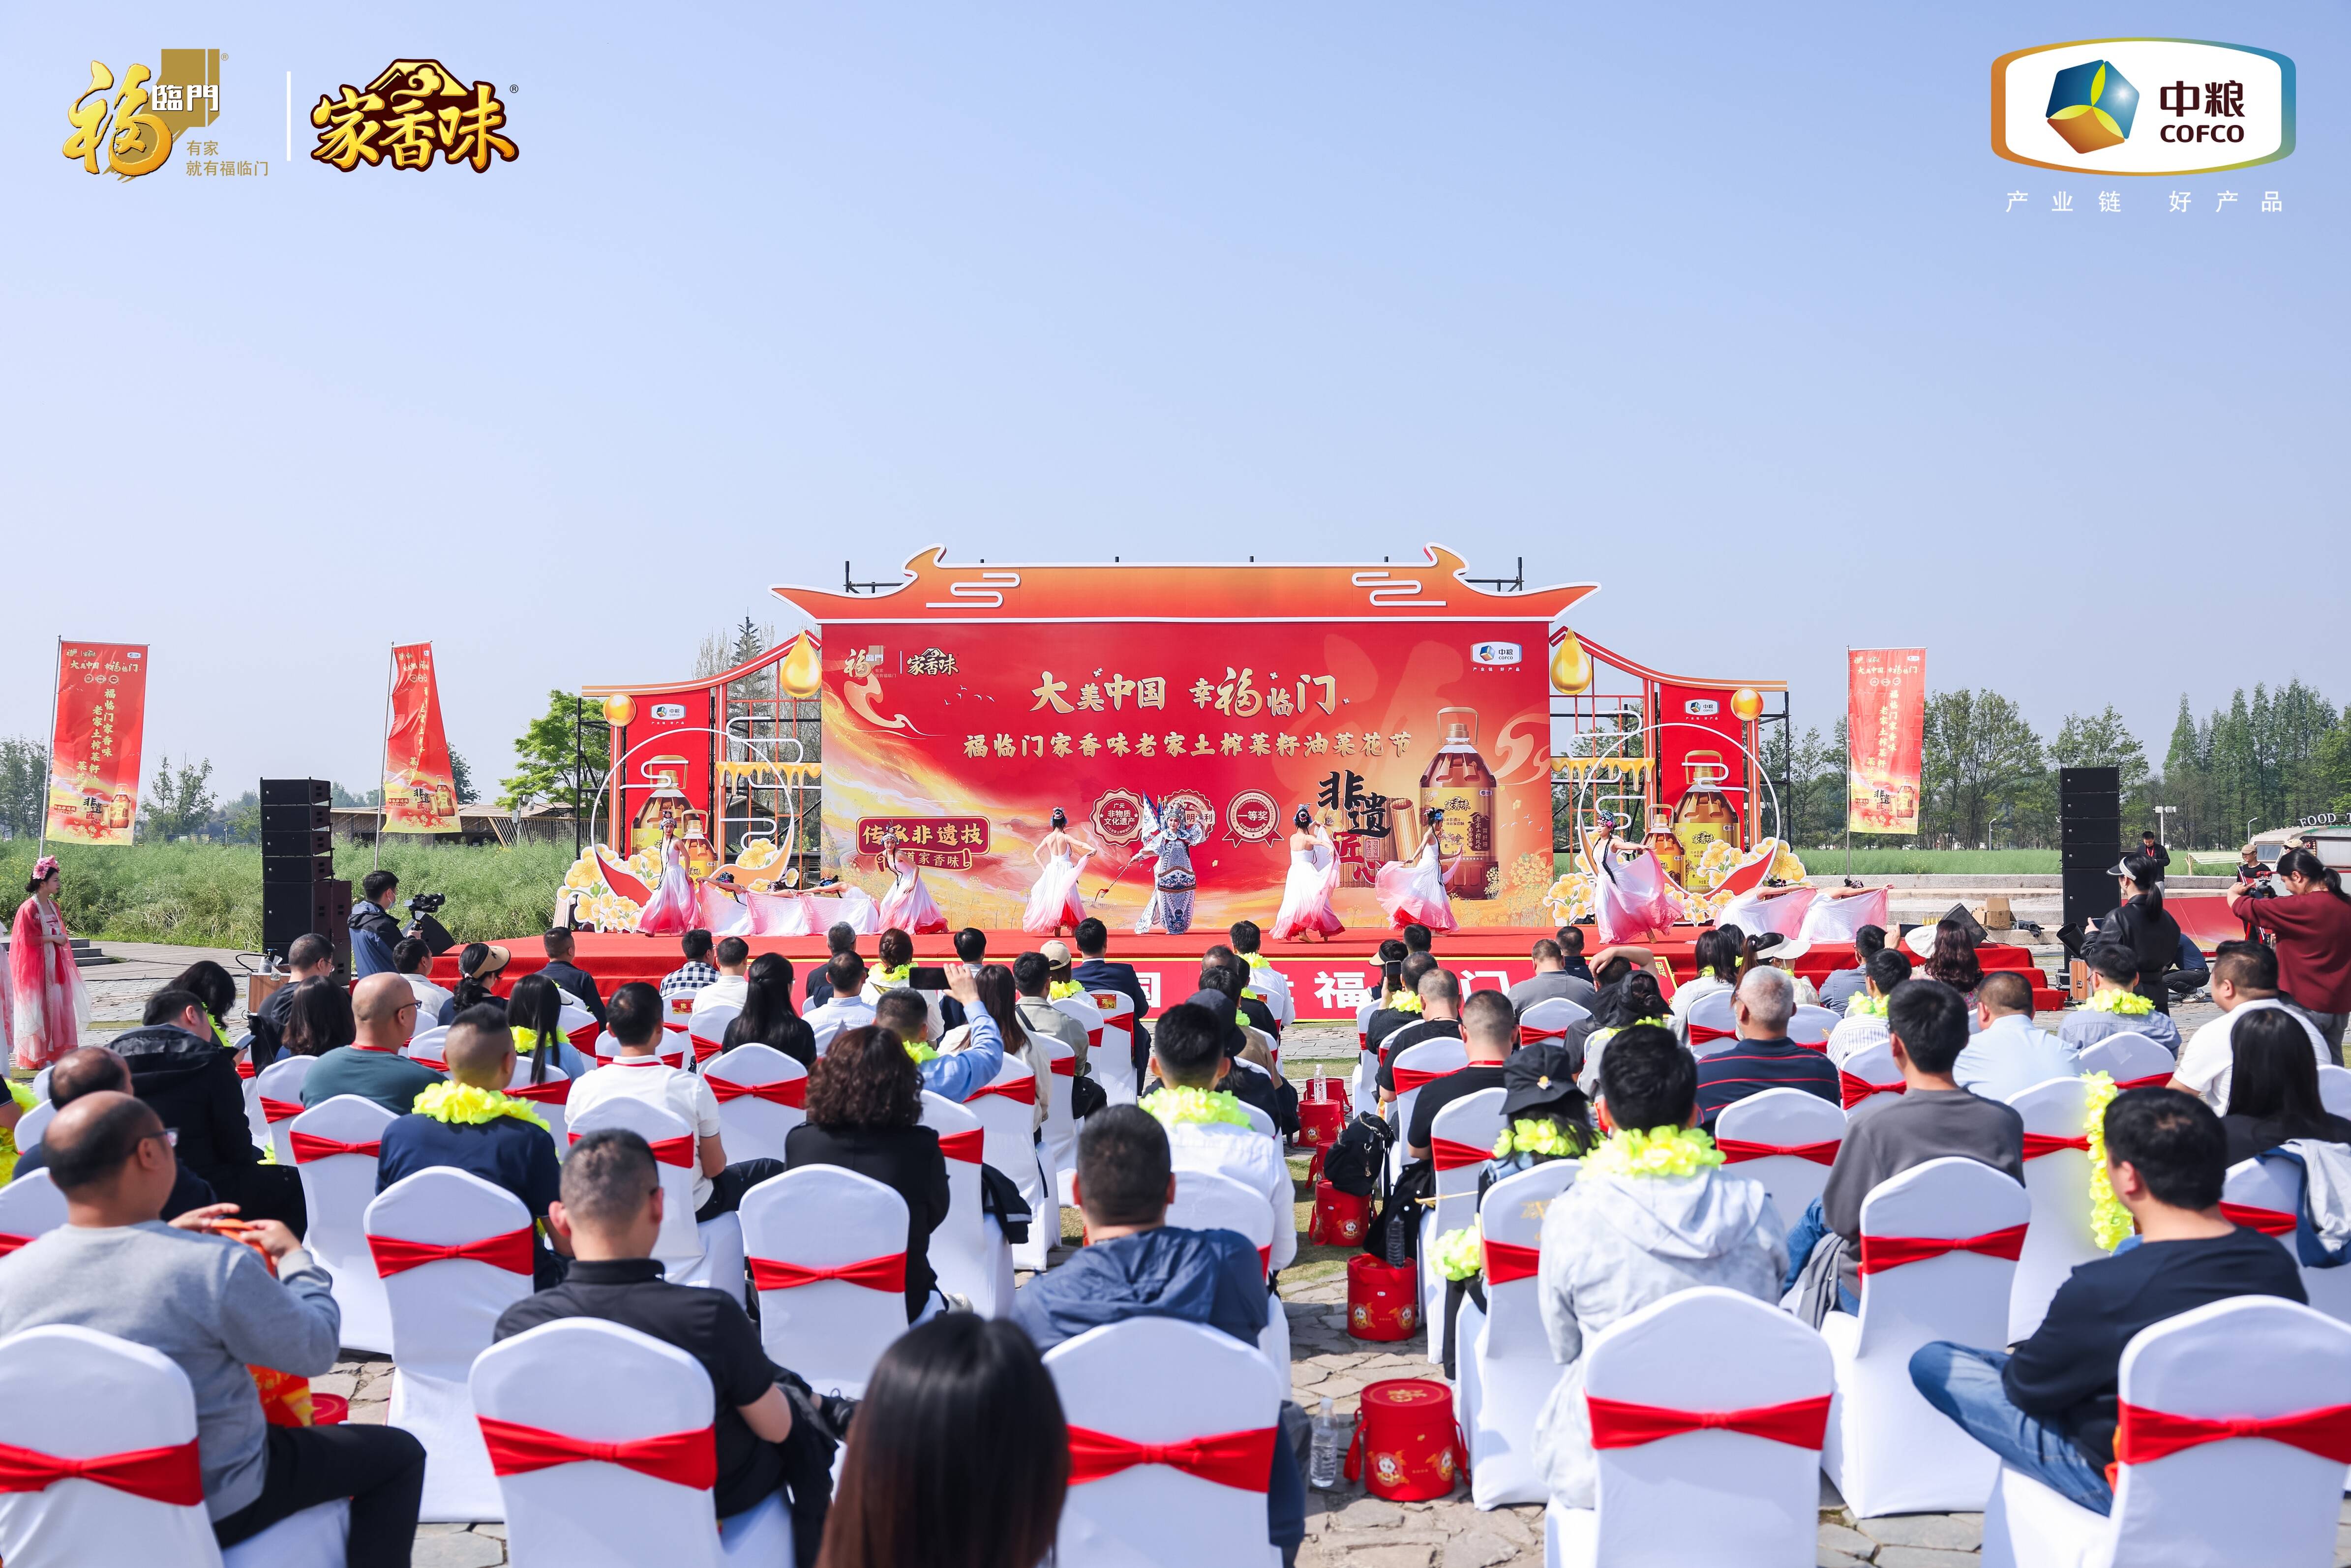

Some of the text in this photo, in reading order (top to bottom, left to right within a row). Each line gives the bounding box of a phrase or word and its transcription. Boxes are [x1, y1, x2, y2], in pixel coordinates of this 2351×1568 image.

[906, 654, 960, 676] 家香味
[1029, 666, 1337, 718] 大美中国 幸福临门
[101, 689, 116, 758] 福临门家香味
[963, 731, 1413, 758] 福临门家香味老家土榨菜籽油菜花节
[1237, 811, 1268, 821] 一等奖
[2299, 813, 2336, 827] FOOD
